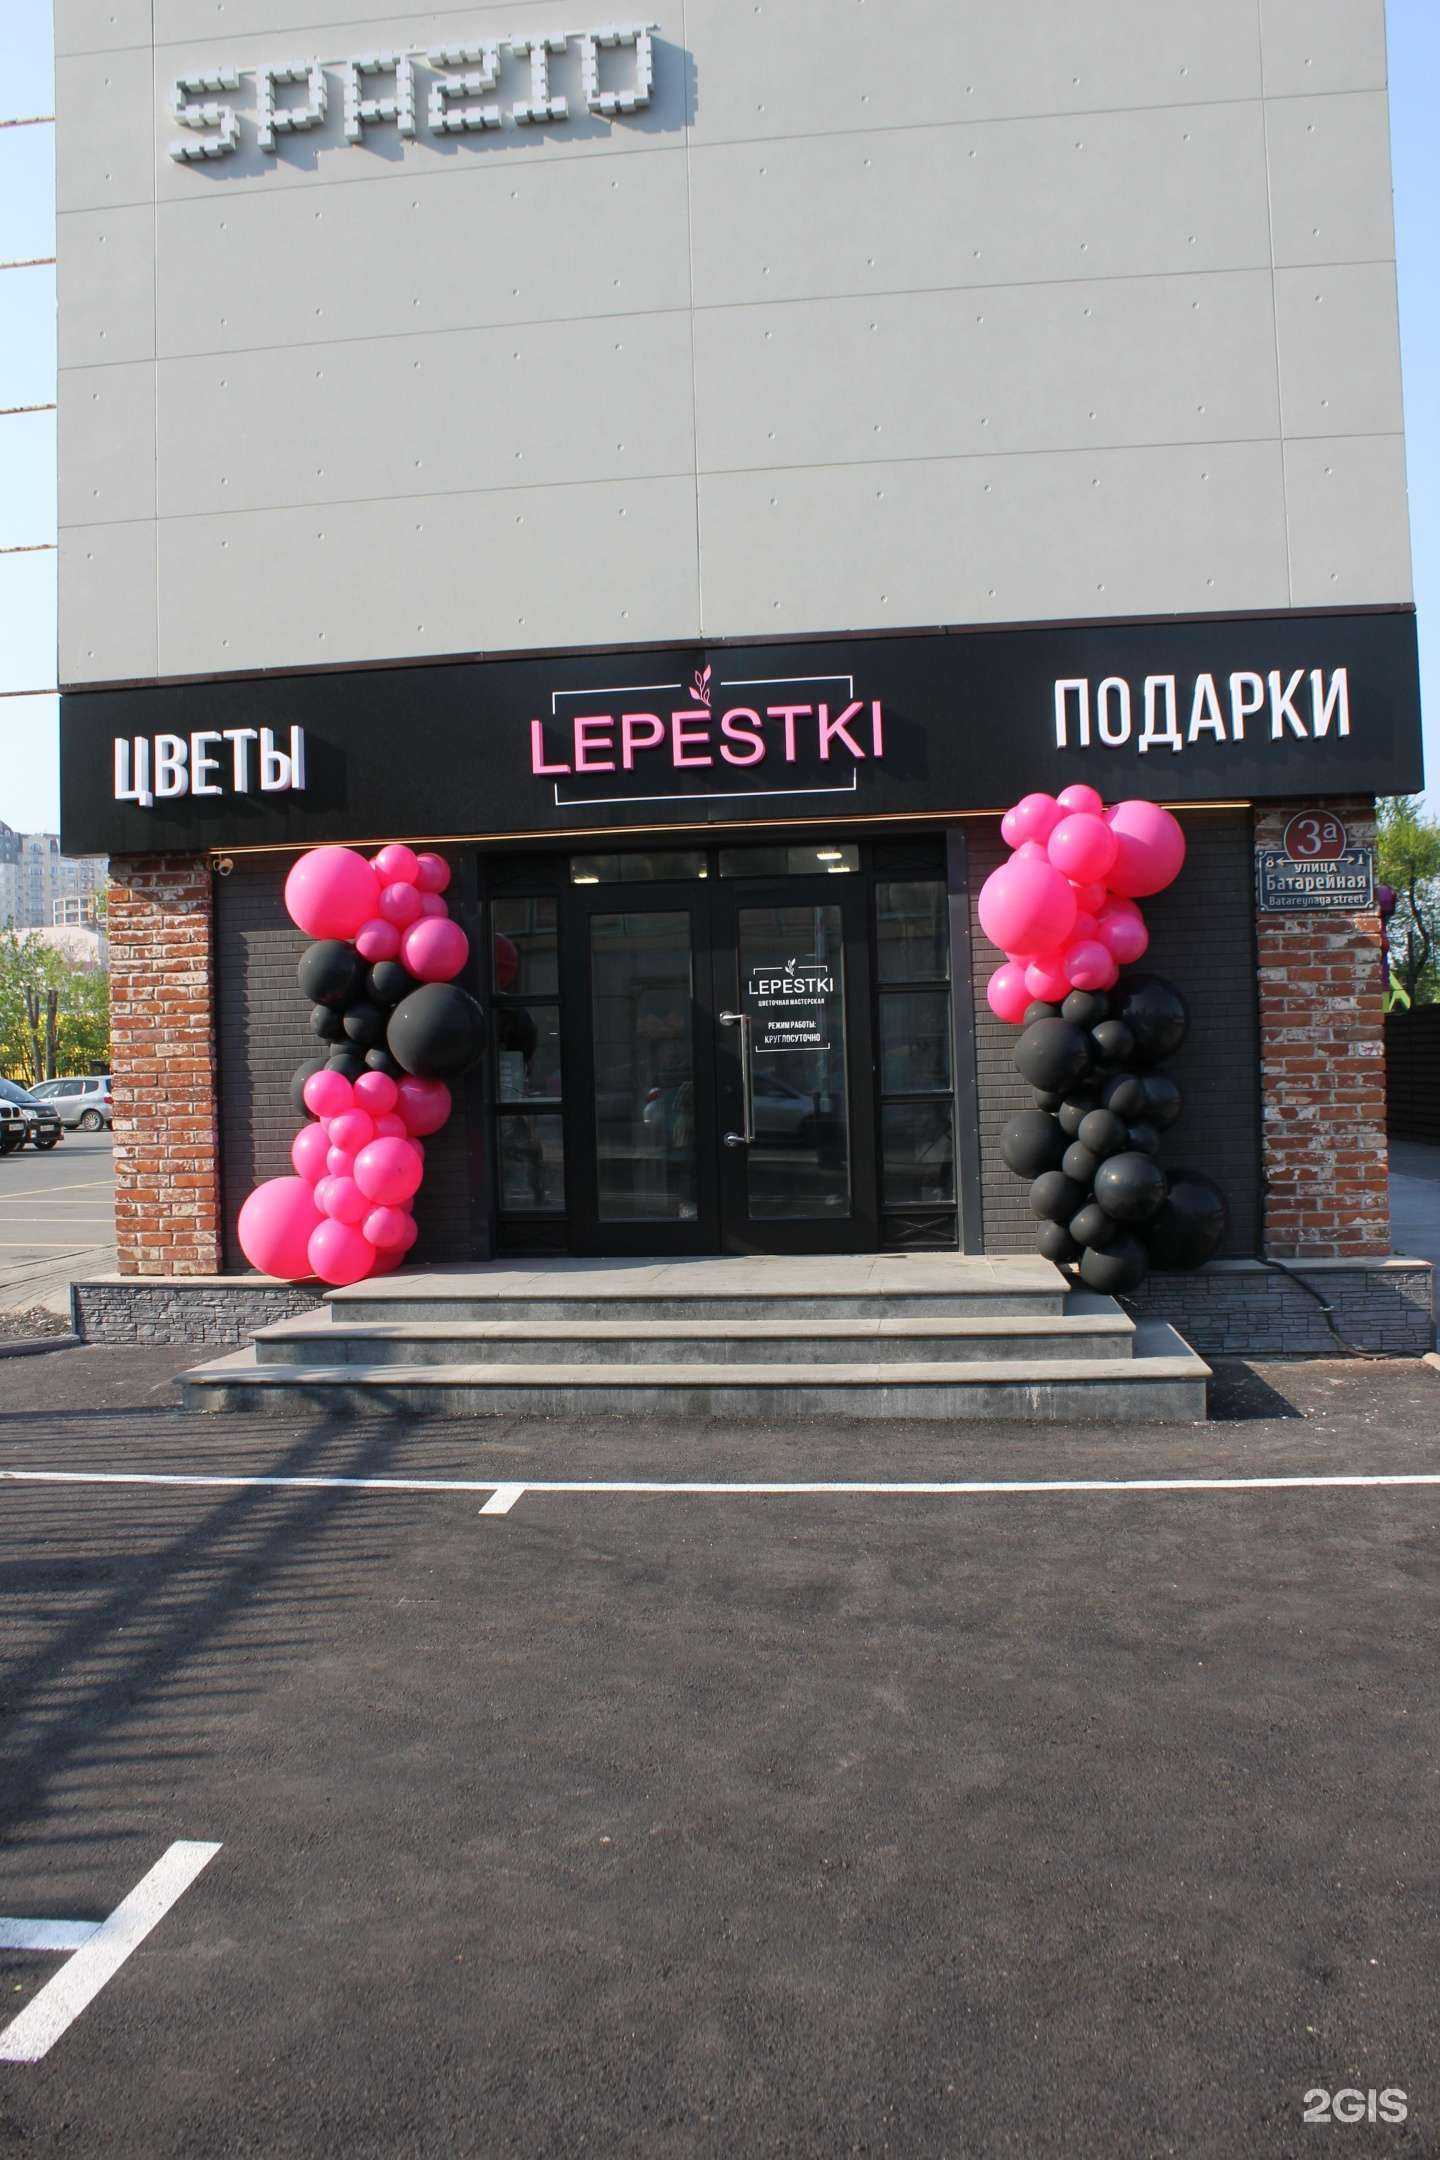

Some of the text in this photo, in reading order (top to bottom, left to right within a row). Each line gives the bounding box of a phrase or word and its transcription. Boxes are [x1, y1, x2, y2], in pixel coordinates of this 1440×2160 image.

[1053, 667, 1350, 754] ПОДАРКИ
[530, 700, 884, 776] LEPESTKI
[113, 725, 305, 807] ЦВЕТЫ
[1294, 862, 1338, 874] УЛИЦА
[1266, 874, 1367, 891] Батарейная
[1333, 894, 1364, 904] street
[748, 978, 834, 994] LEPESTKI
[768, 1020, 817, 1030] РЕЖИМ РАБОТЫ:
[764, 1033, 821, 1044] КРУГЛОСУТОЧНО
